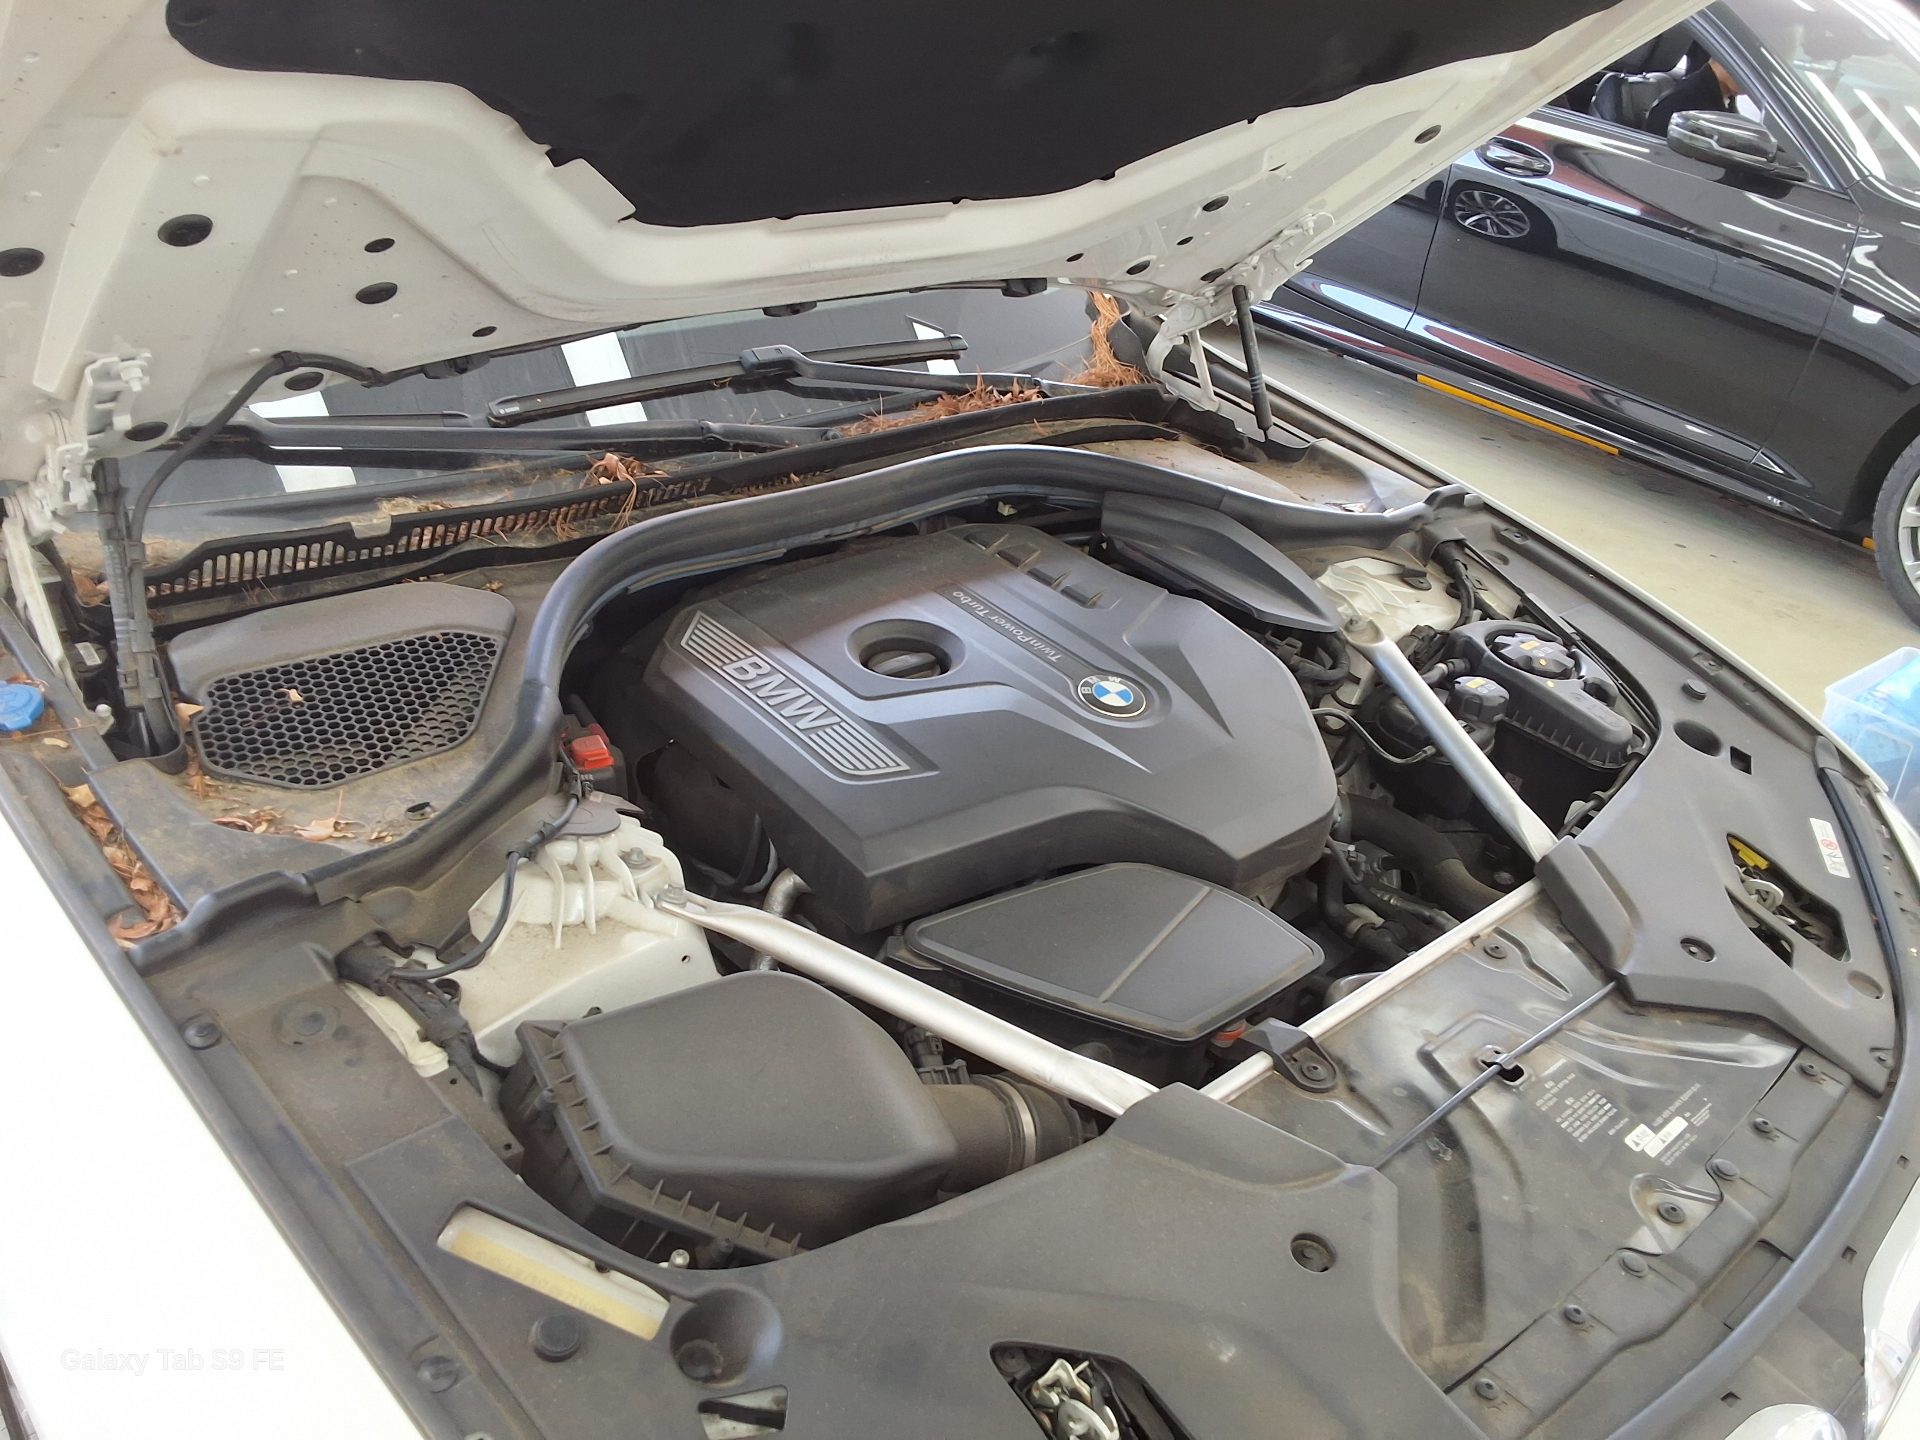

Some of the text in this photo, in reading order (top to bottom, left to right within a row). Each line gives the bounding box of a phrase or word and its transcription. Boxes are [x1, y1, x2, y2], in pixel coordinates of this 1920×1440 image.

[953, 591, 1062, 663] TwinPower Turbo
[722, 656, 842, 730] BMW
